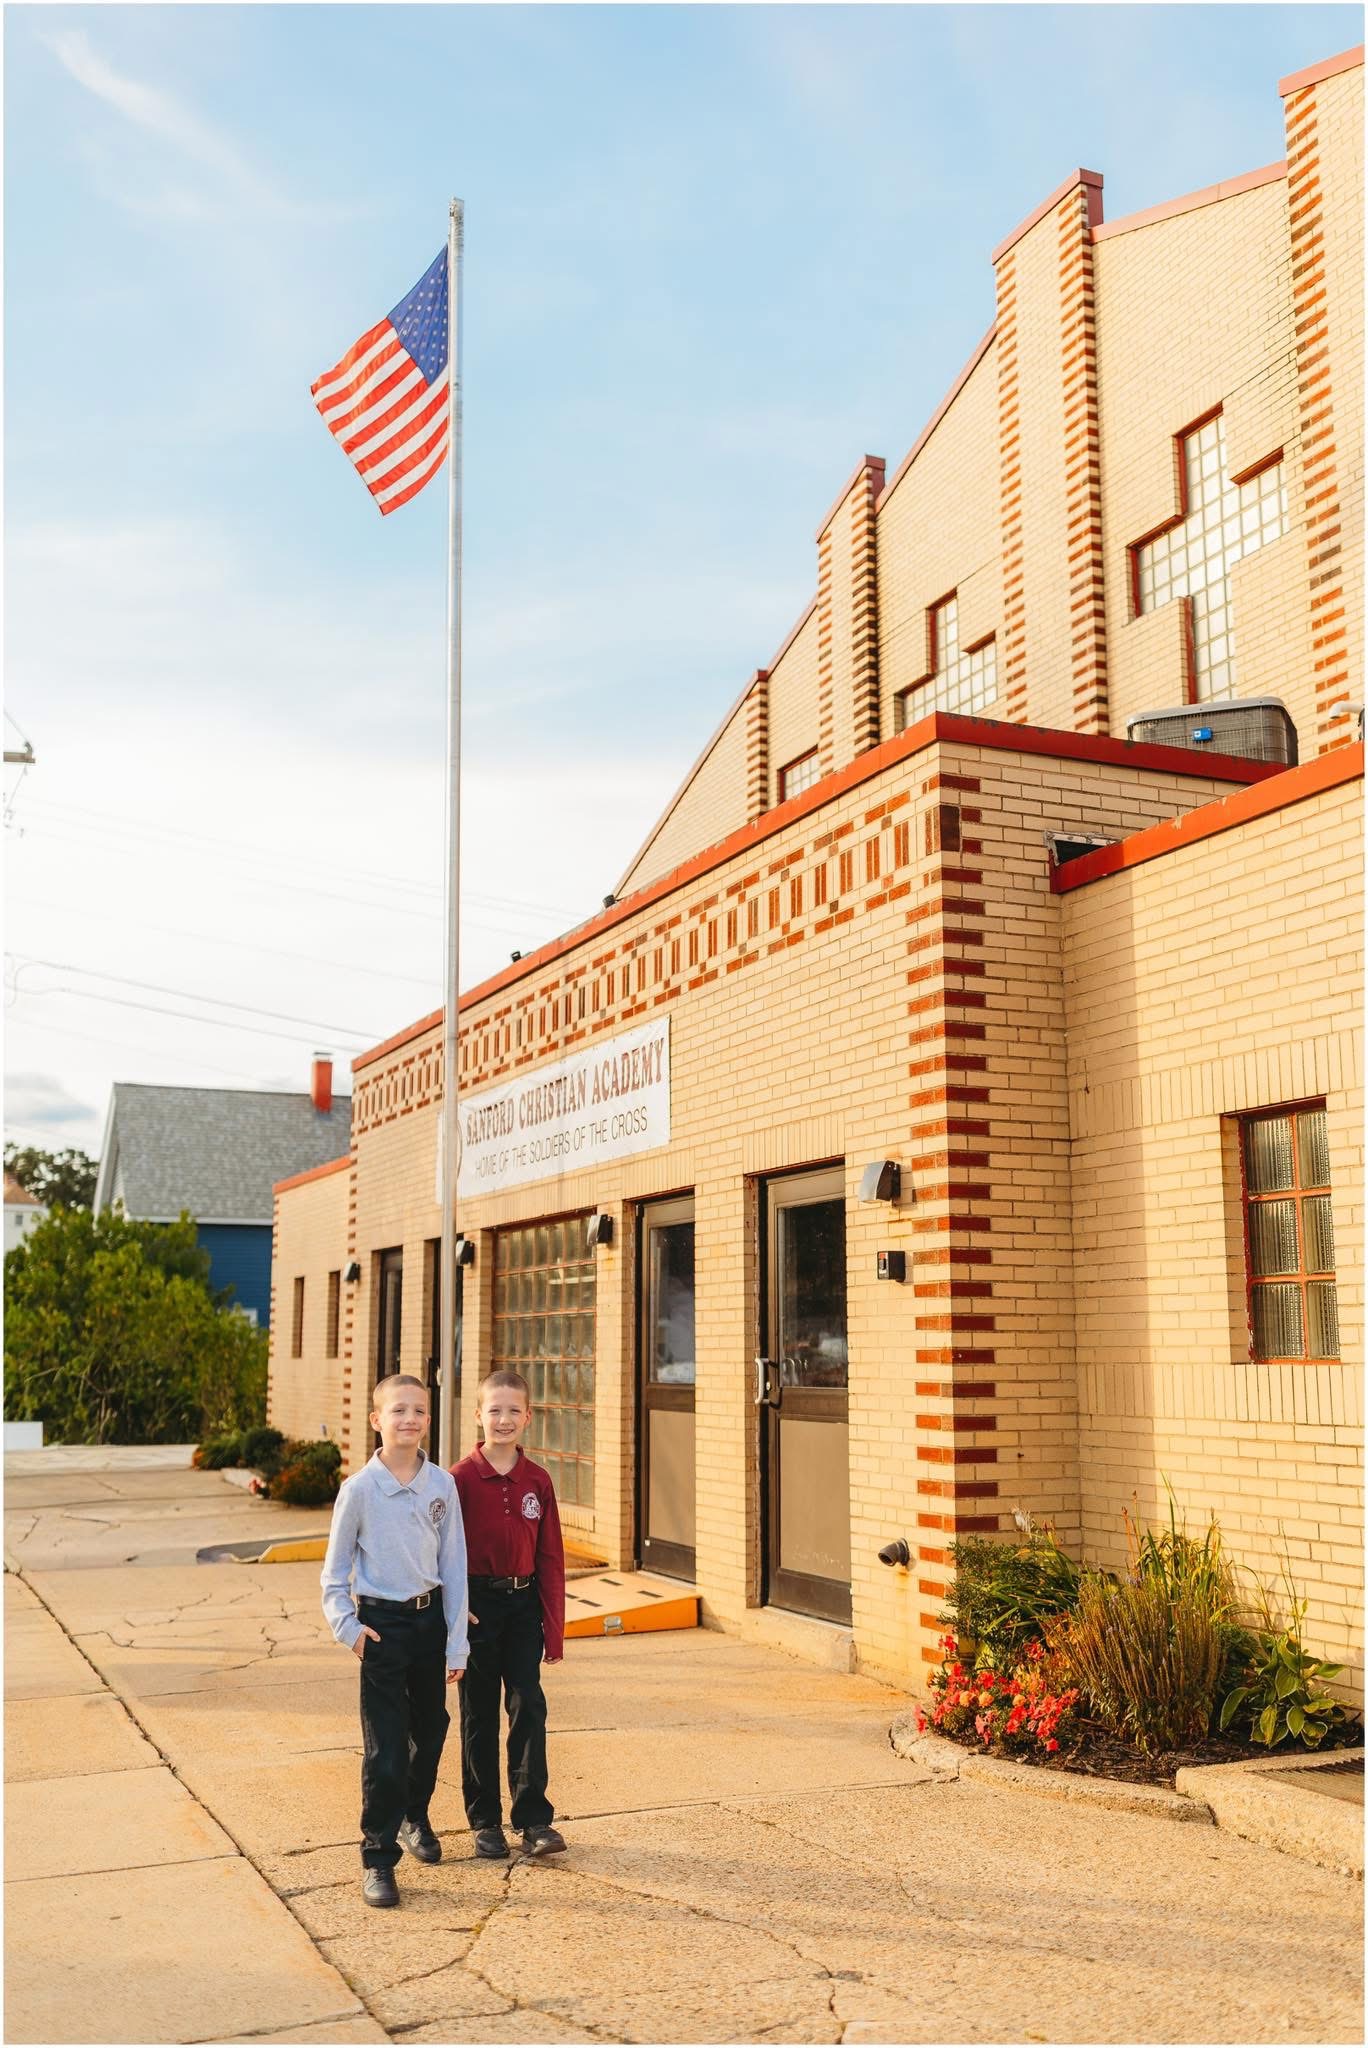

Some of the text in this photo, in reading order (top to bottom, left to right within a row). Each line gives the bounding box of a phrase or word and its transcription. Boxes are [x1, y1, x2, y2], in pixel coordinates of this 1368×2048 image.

[466, 1038, 665, 1146] SANFORD CHRISTIAN ACADEMY
[475, 1106, 648, 1178] HOME OF THE SOLDIERS OF THE CROSS
